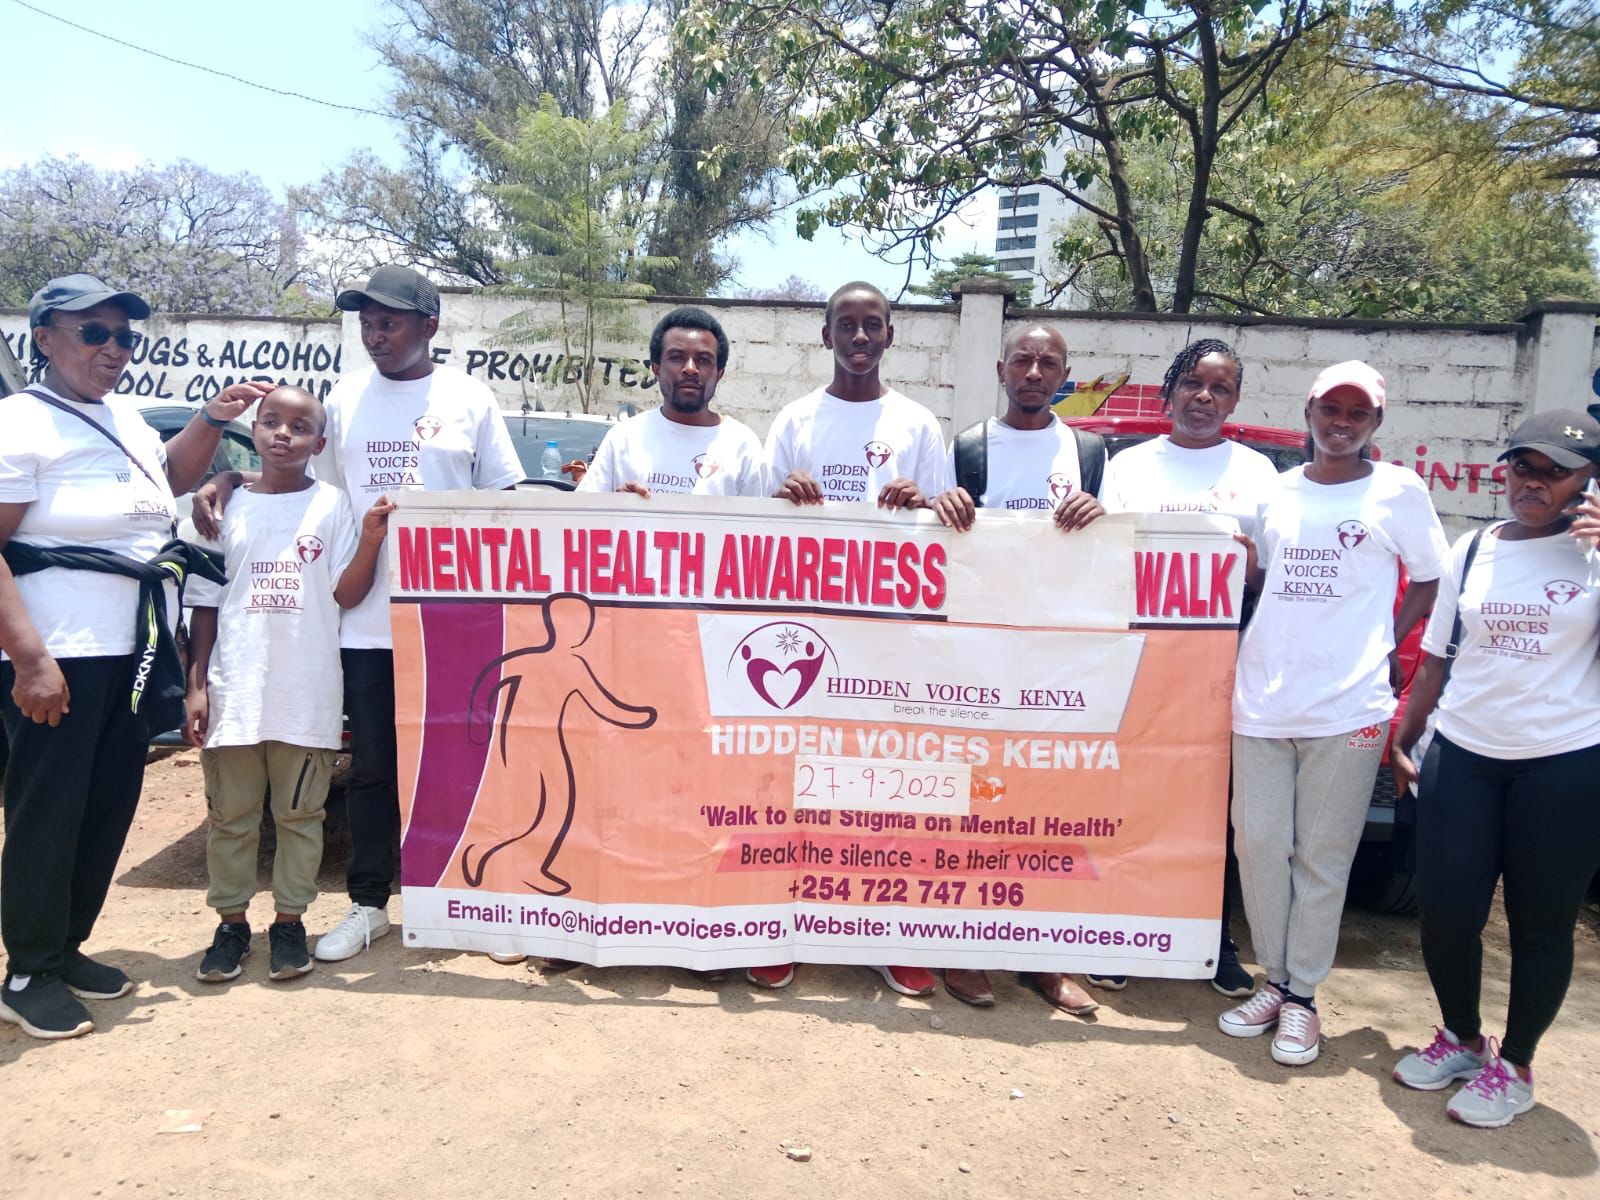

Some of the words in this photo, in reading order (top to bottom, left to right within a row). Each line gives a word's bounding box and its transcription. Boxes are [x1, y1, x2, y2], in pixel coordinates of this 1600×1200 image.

[130, 336, 190, 364] UGS
[197, 343, 214, 367] &
[367, 440, 420, 452] HIDDEN
[368, 456, 418, 468] VOICES
[370, 472, 415, 485] KENYA
[648, 472, 698, 487] HIDDEN
[1006, 498, 1055, 510] HIDDEN
[1160, 503, 1217, 512] HIDDEN
[1283, 547, 1342, 560] HIDDEN
[251, 561, 302, 573] HIDDEN
[398, 527, 552, 592] MENTAL
[563, 529, 705, 597] HEALTH
[714, 534, 947, 609] AWARENESS
[1134, 551, 1238, 618] WALK
[1284, 564, 1338, 577] VOICES
[252, 578, 300, 590] VOICES
[1283, 581, 1333, 594] KENYA
[251, 594, 297, 606] KENYA
[1480, 602, 1551, 616] HIDDEN
[1484, 619, 1548, 634] VOICES
[1490, 635, 1541, 652] KENYA
[133, 642, 156, 692] DKNY
[826, 677, 911, 698] HIDDEN
[926, 683, 1000, 705] VOICES
[1019, 689, 1087, 707] KENYA
[893, 702, 925, 716] break
[929, 704, 946, 717] the
[711, 724, 843, 756] HIDDEN
[856, 727, 989, 766] VOICES
[1003, 738, 1120, 770] KENYA
[766, 806, 787, 825] to
[794, 808, 831, 824] end
[840, 810, 917, 832] Stigma
[925, 814, 952, 832] on
[960, 814, 1036, 836] Mental
[741, 840, 799, 865] Break
[801, 839, 833, 865] the
[840, 844, 912, 868] silence
[935, 848, 960, 870] Be
[967, 849, 1010, 871] their
[1017, 850, 1073, 873] voice
[788, 874, 851, 901] +254
[861, 878, 908, 903] 722
[918, 880, 967, 905] 747
[978, 881, 1024, 907] 196
[448, 900, 513, 924] Email:
[520, 905, 787, 940] info@hidden-voices.org,
[794, 912, 892, 937] Website:
[899, 919, 1172, 953] www.hidden-voices.org
